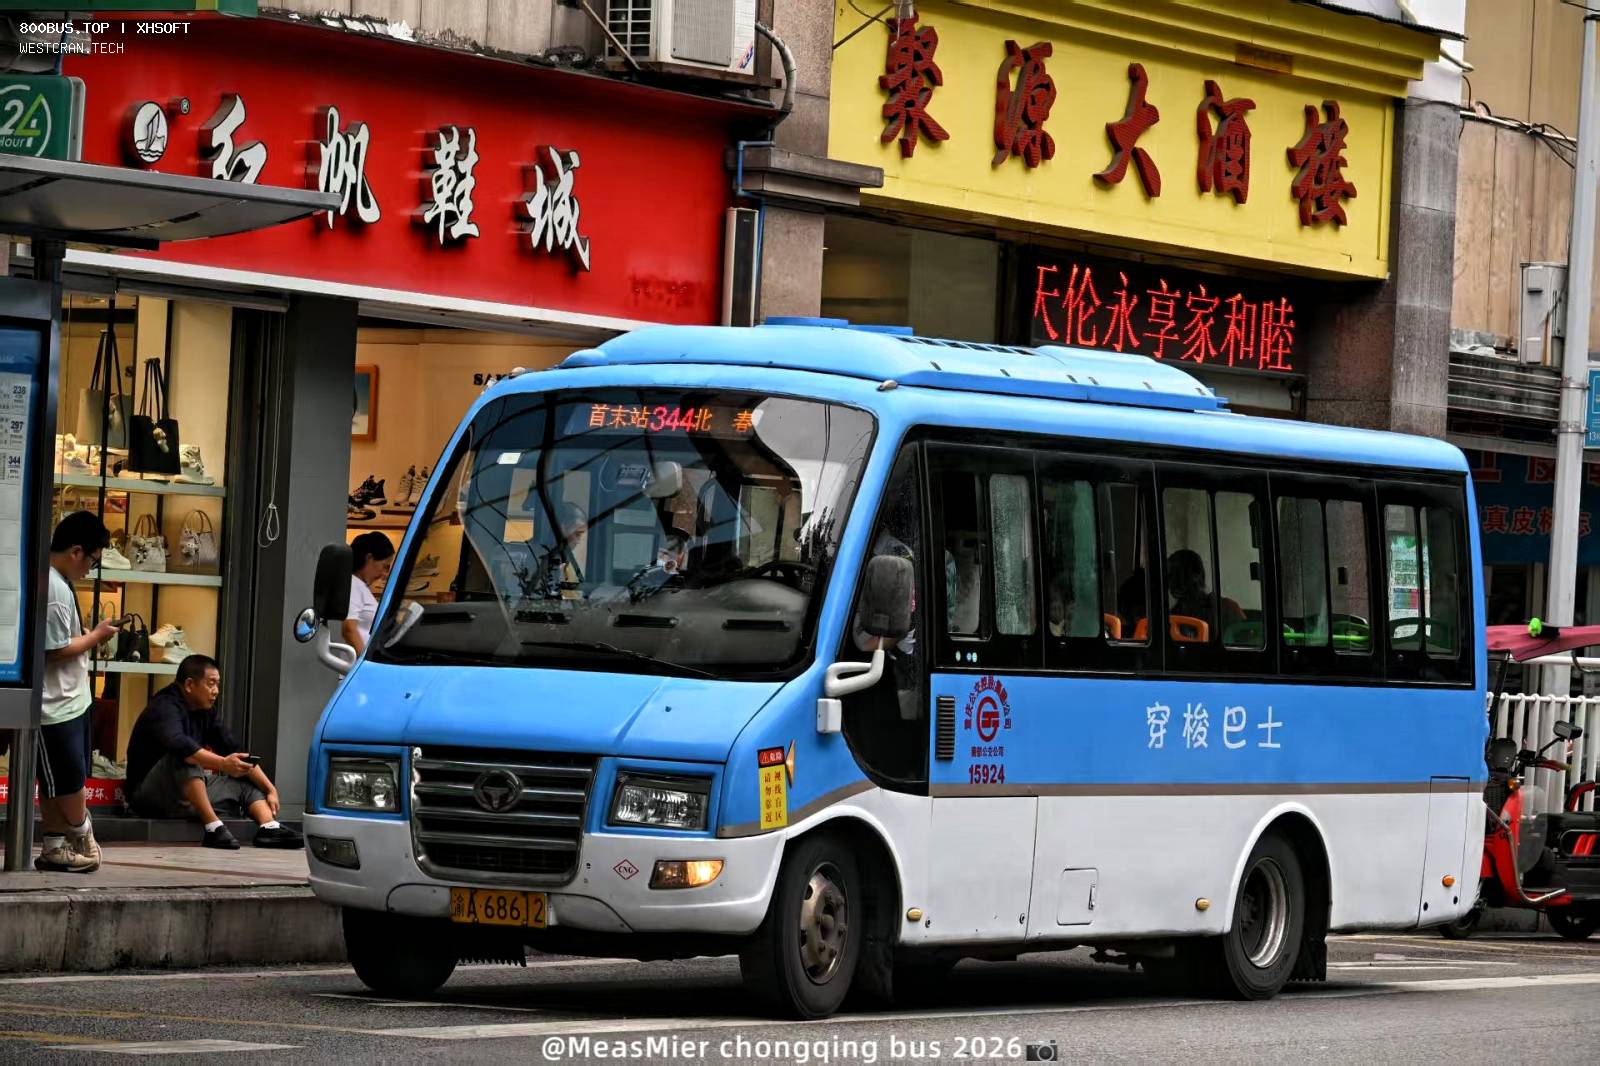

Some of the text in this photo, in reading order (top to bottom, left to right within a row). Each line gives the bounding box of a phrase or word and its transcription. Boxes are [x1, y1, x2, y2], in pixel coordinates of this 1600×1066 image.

[879, 11, 1358, 227] 聚源大酒楼
[11, 420, 24, 431] 297
[8, 455, 21, 465] 344
[1146, 702, 1283, 750] 穿梭巴士
[968, 763, 1006, 784] 15924
